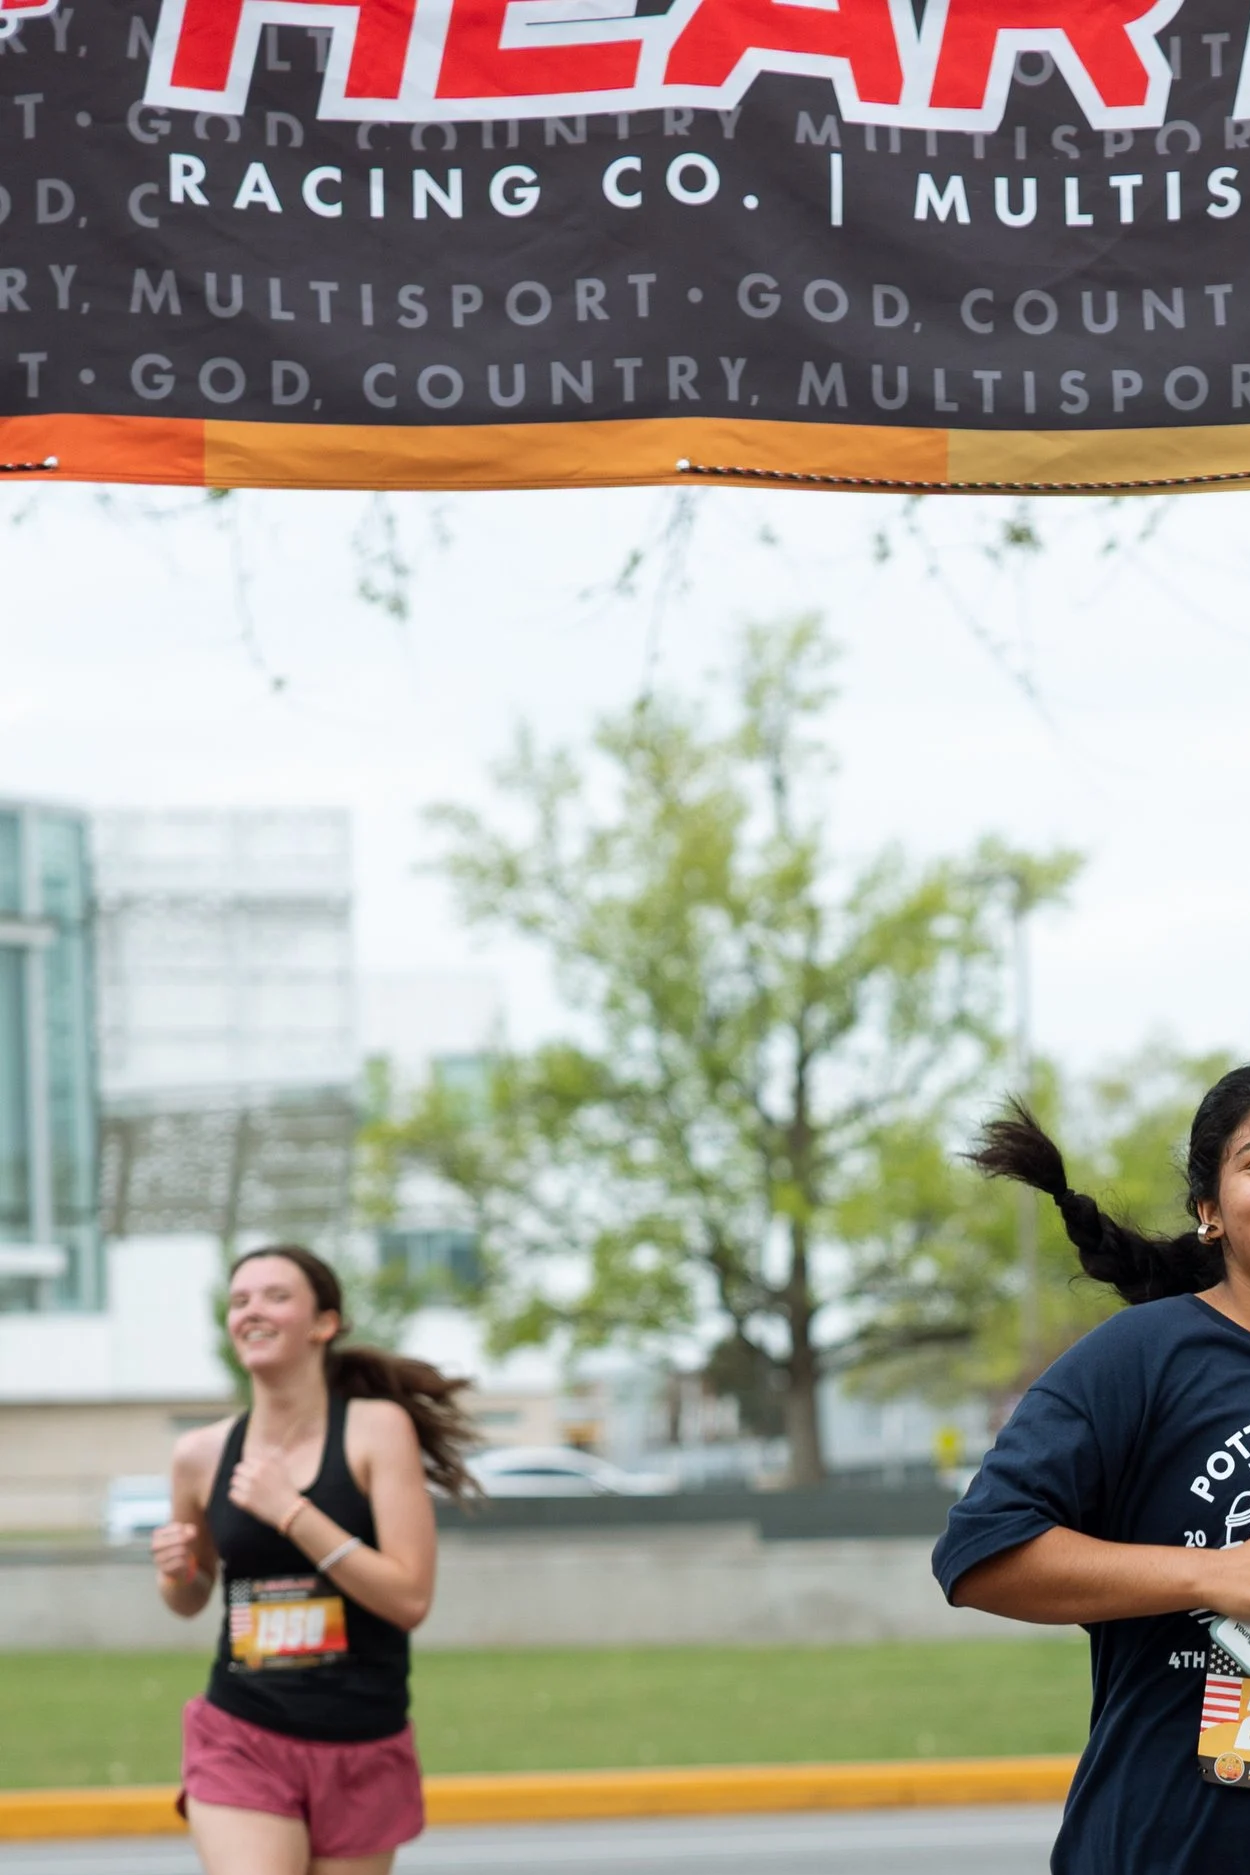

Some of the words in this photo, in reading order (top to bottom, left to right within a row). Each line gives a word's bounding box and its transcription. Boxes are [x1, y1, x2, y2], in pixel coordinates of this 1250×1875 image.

[168, 152, 541, 219] RACING
[602, 153, 759, 210] CO.
[130, 270, 656, 328] MULTISPORT
[737, 273, 923, 334] GOD,
[130, 354, 323, 411] GOD,
[363, 356, 759, 409] COUNTRY,
[1168, 1651, 1206, 1669] 4TH
